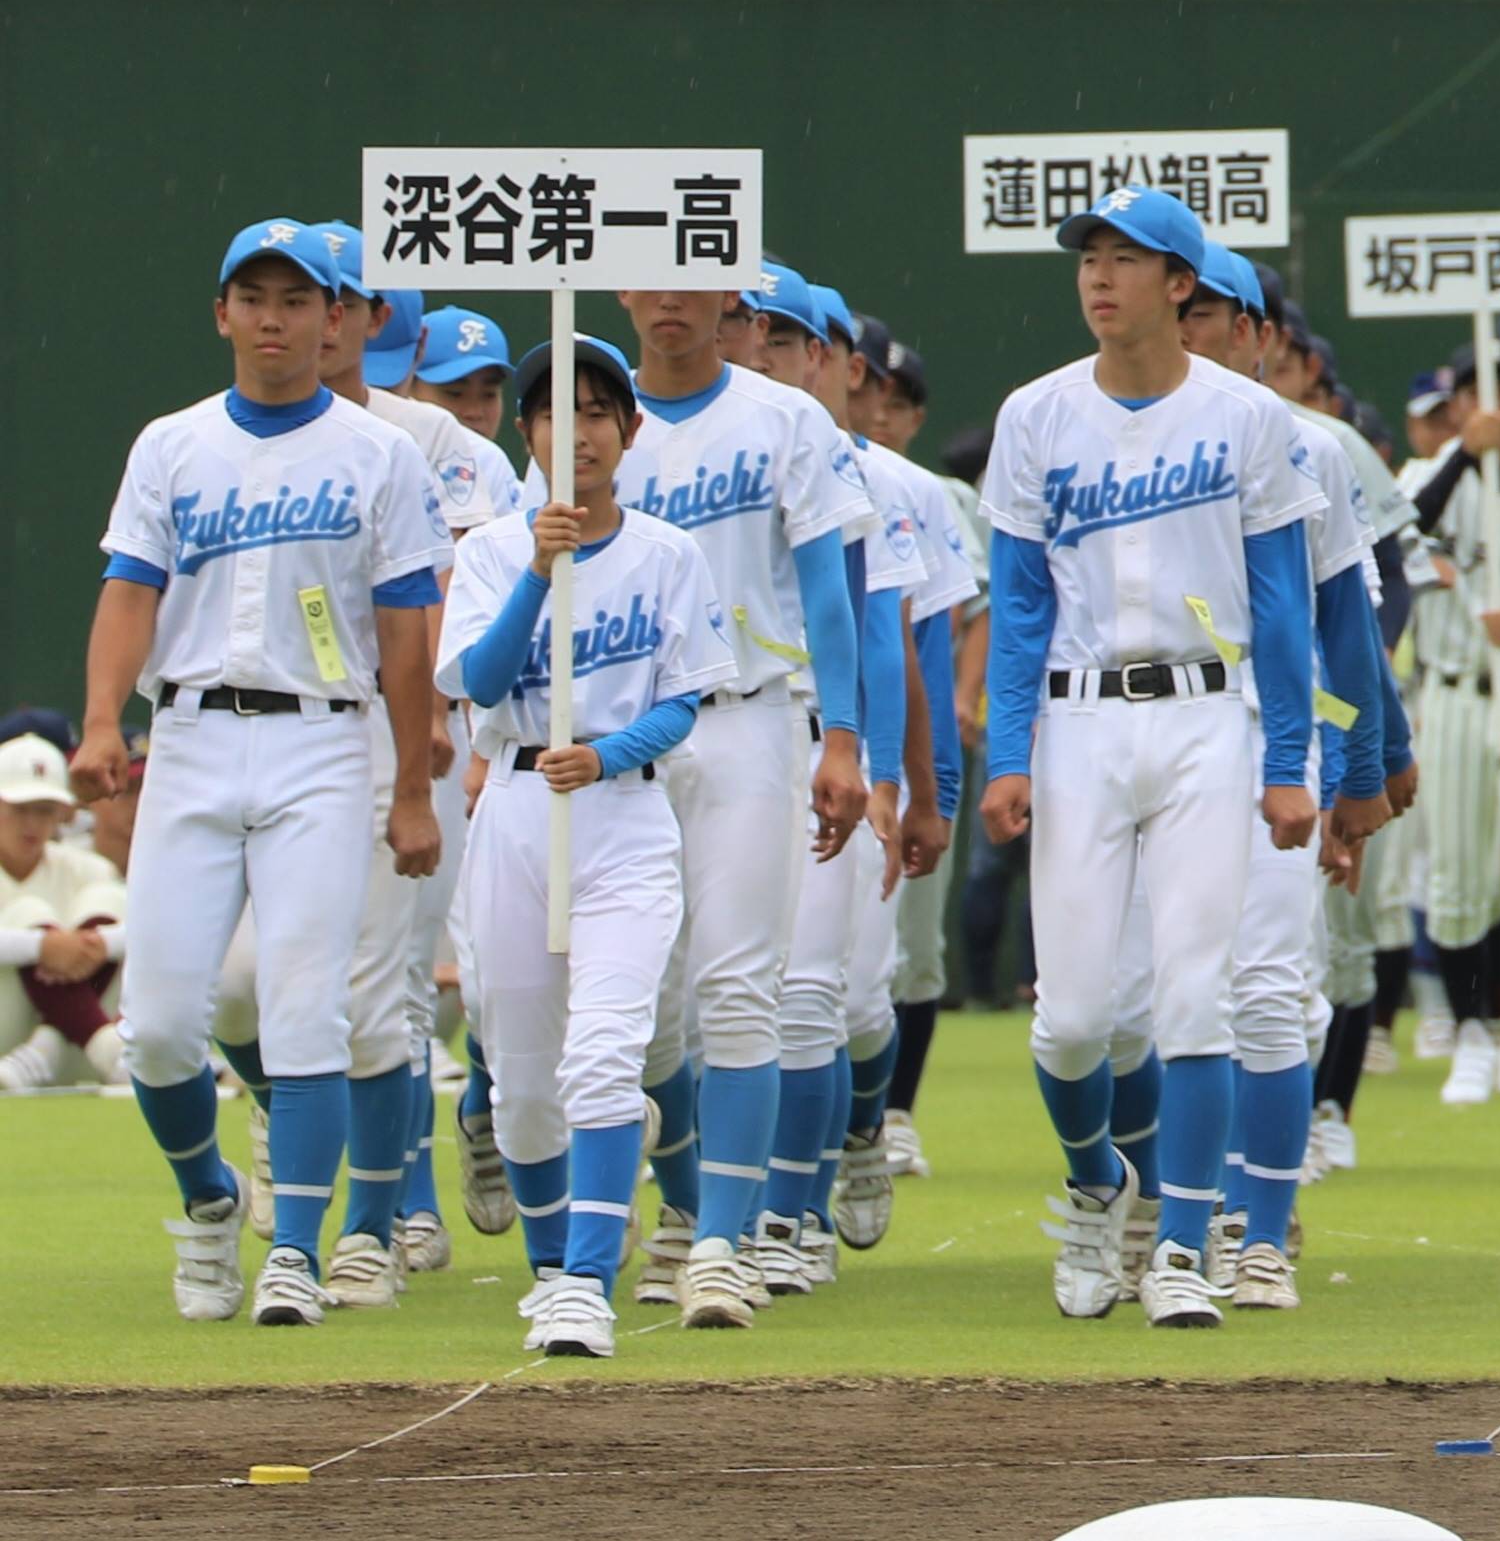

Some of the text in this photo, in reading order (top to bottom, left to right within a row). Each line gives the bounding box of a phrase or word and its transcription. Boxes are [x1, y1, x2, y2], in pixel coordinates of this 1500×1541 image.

[382, 173, 741, 266] 深谷第一高
[172, 478, 360, 561] Fukaichi
[622, 449, 773, 523] kaichi
[1043, 440, 1237, 538] Fukaichi
